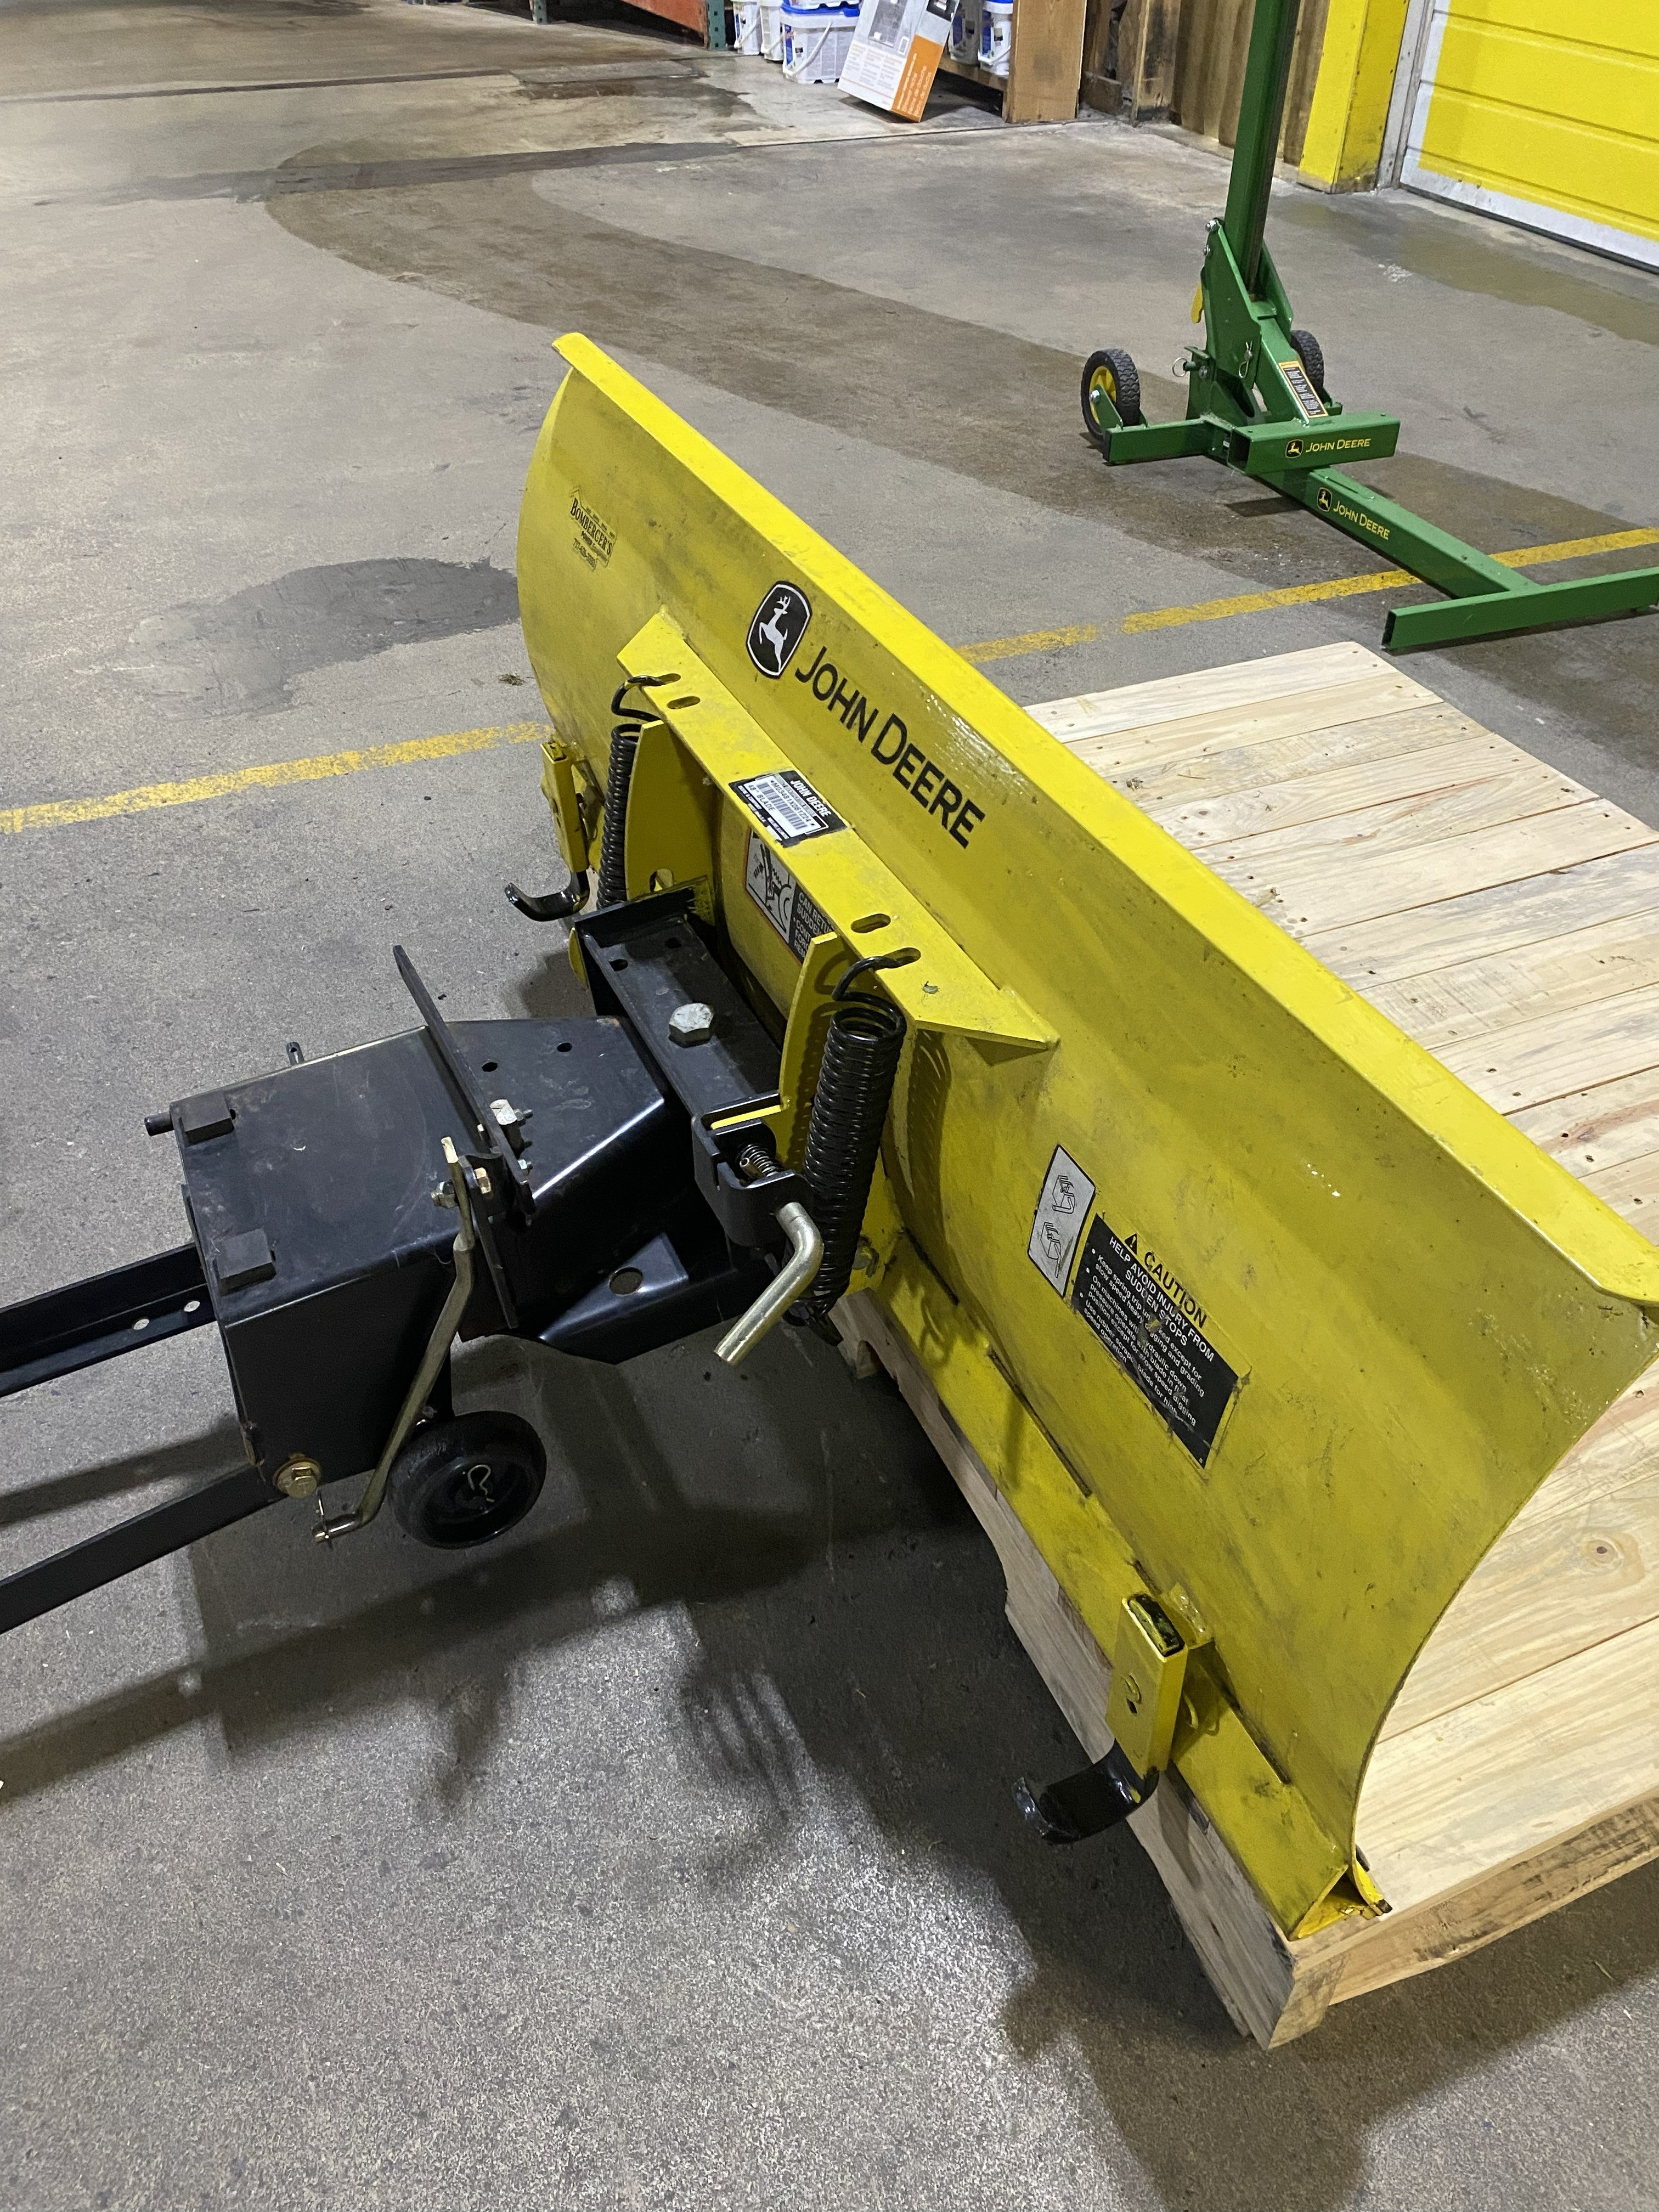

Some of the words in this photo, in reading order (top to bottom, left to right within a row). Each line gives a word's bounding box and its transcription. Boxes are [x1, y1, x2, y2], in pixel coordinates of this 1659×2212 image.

[1305, 442, 1335, 453] JOHN
[1337, 438, 1372, 450] DEERE
[1333, 500, 1359, 523] JOHN
[1359, 513, 1391, 541] DEERE
[794, 645, 879, 743] JOHN
[870, 713, 986, 850] DEERE
[756, 794, 776, 811] BLADE
[791, 781, 811, 797] JOHN
[806, 796, 831, 816] DEERE
[797, 919, 811, 942] CONT
[799, 892, 812, 914] CAN
[812, 909, 832, 934] RETU
[1098, 1254, 1113, 1275] Keep
[1113, 1274, 1131, 1299] spring
[1131, 1295, 1142, 1310] trip
[1142, 1308, 1171, 1344] unked
[1170, 1342, 1192, 1369] except
[1191, 1366, 1202, 1380] for
[1109, 1236, 1131, 1262] HELP
[1130, 1263, 1156, 1294] AVOID
[1156, 1291, 1188, 1330] INJURY
[1188, 1328, 1215, 1362] FROM
[1125, 1269, 1159, 1312] SUDDEN
[1159, 1309, 1187, 1346] STOPS
[1144, 1251, 1207, 1328] CAUTION
[1084, 1307, 1101, 1330] speed
[1101, 1329, 1127, 1363] operation
[1086, 1299, 1096, 1316] Use
[1097, 1314, 1115, 1338] rubber
[1137, 1363, 1154, 1387] blade
[1154, 1385, 1164, 1398] for
[1088, 1290, 1110, 1319] position
[1111, 1318, 1130, 1344] except
[1130, 1341, 1139, 1353] for
[1138, 1353, 1154, 1372] slow
[1154, 1372, 1173, 1396] speed
[1173, 1395, 1196, 1426] digging
[1090, 1283, 1114, 1314] pressure
[1114, 1313, 1136, 1341] operate
[1150, 1355, 1167, 1378] blade
[1167, 1376, 1173, 1387] in
[1092, 1275, 1101, 1288] On
[1101, 1286, 1128, 1321] machines
[1141, 1336, 1169, 1370] ydraulic
[1169, 1370, 1187, 1392] down
[1095, 1263, 1109, 1281] slow
[1109, 1280, 1127, 1302] speed
[1126, 1300, 1144, 1324] heavy
[1167, 1351, 1181, 1367] and
[1180, 1366, 1205, 1397] grading
